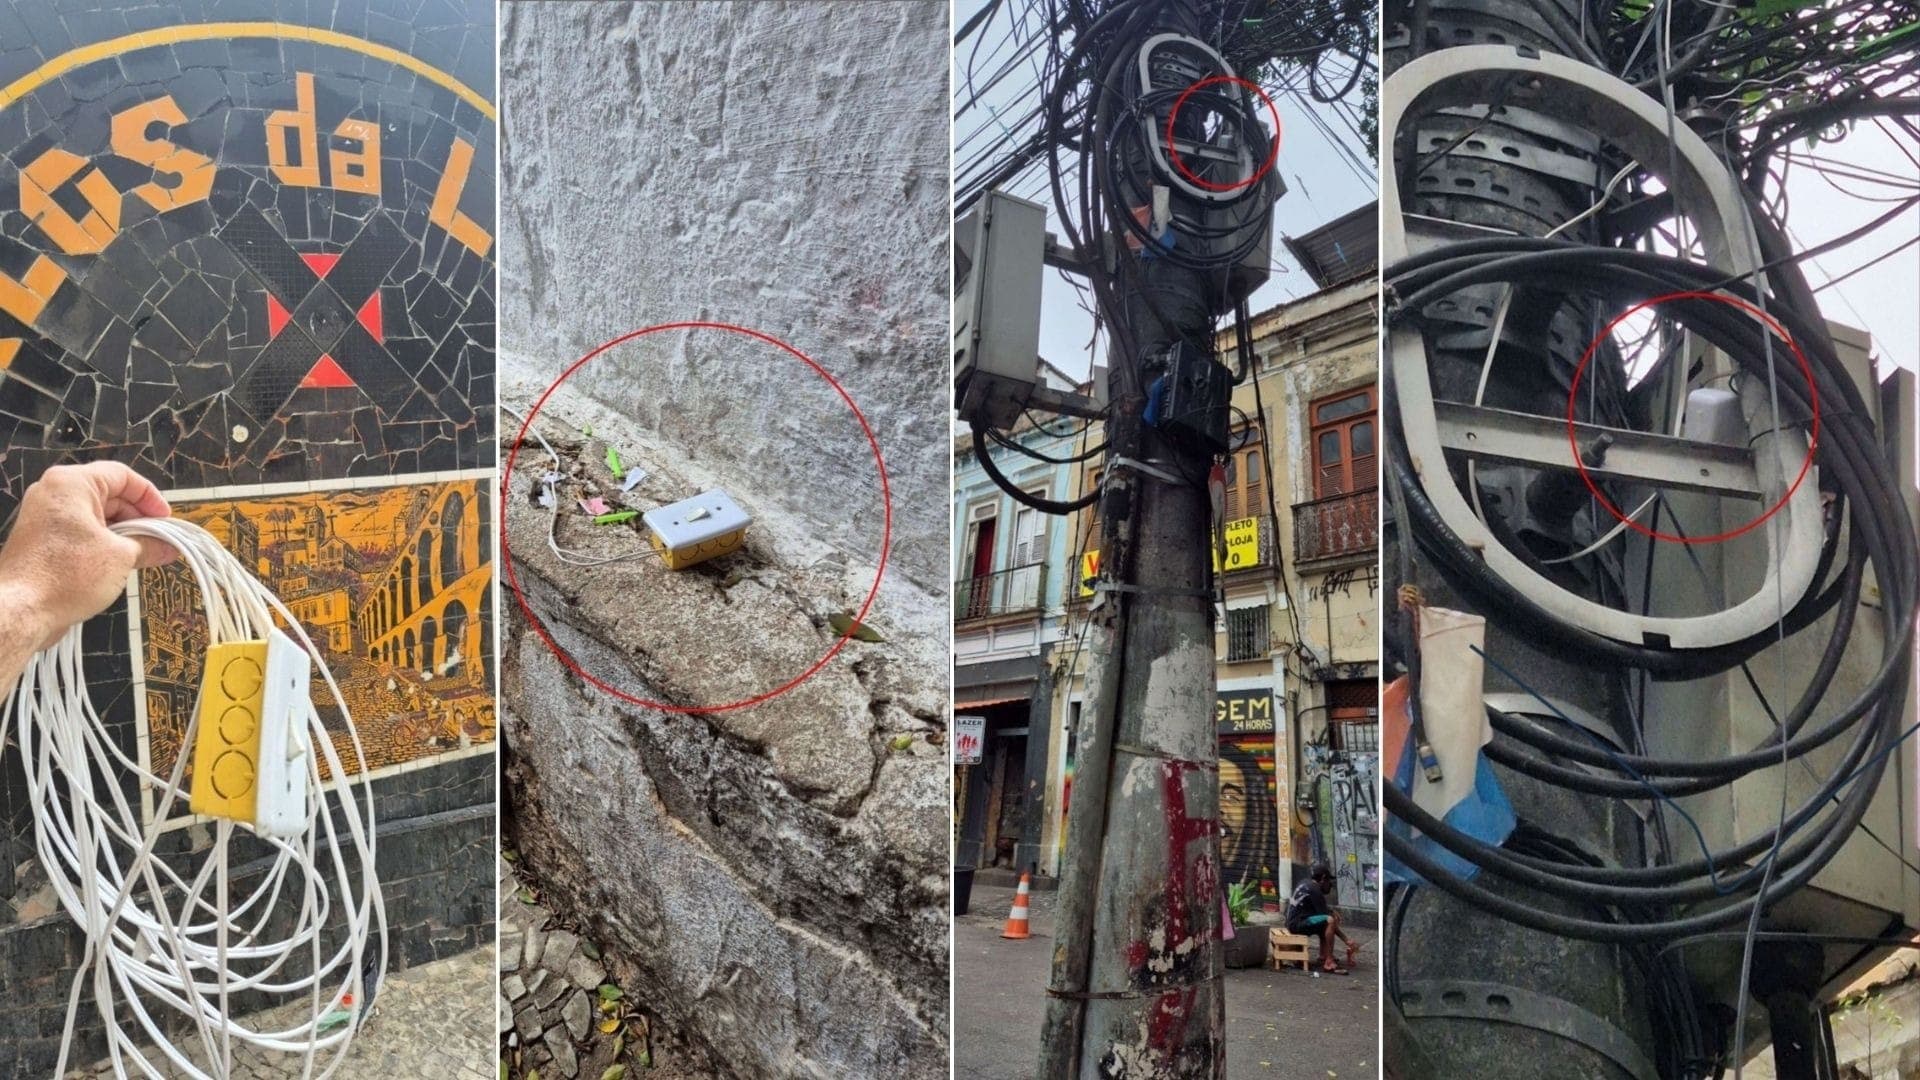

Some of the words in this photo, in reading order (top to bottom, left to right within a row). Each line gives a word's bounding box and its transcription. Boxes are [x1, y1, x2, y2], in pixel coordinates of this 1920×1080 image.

[265, 72, 382, 195] da
[1233, 721, 1244, 731] 24
[1245, 719, 1273, 731] HORAS
